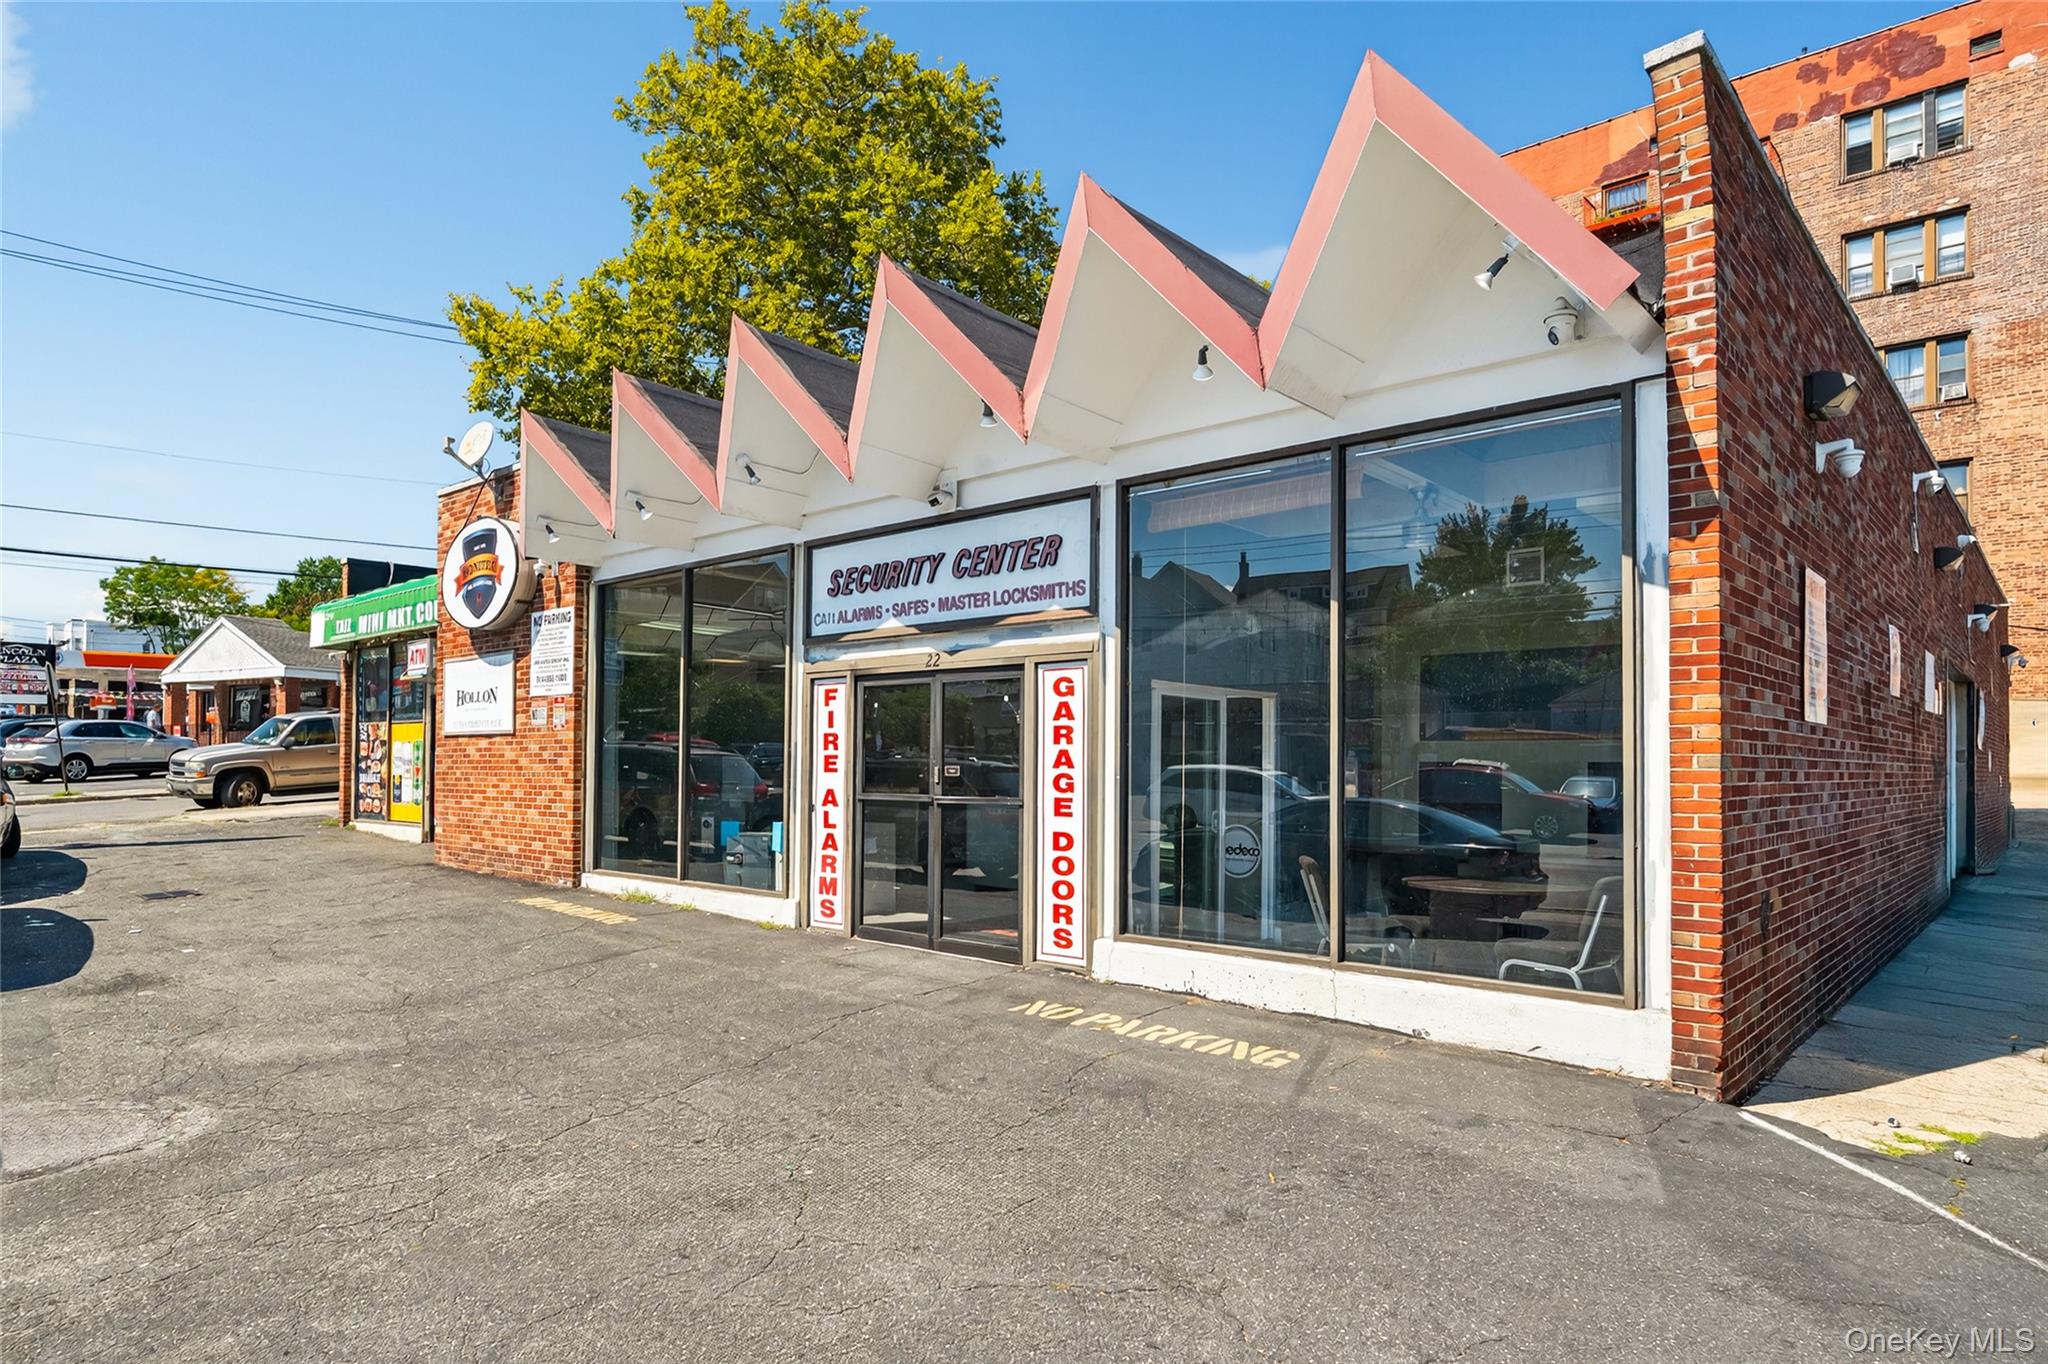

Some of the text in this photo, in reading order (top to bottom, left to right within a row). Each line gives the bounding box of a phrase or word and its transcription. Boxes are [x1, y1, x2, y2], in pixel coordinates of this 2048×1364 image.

[827, 534, 1062, 598] SECURITY CENTER
[837, 605, 883, 624] ALARMS
[891, 599, 929, 618] SAFES
[938, 591, 990, 612] MASTER
[993, 579, 1086, 605] LOCKSMITHS
[358, 611, 384, 634] MINI
[544, 610, 572, 625] PARKING
[0, 647, 47, 656] NCOLN
[410, 647, 427, 665] ATM
[925, 652, 941, 668] 22
[456, 685, 498, 707] HOLLON
[819, 688, 839, 919] FIRE ALARMS
[1051, 676, 1075, 950] GARAGE DOORS
[1225, 843, 1261, 857] edeco
[1007, 1000, 1301, 1069] NO PARKING
